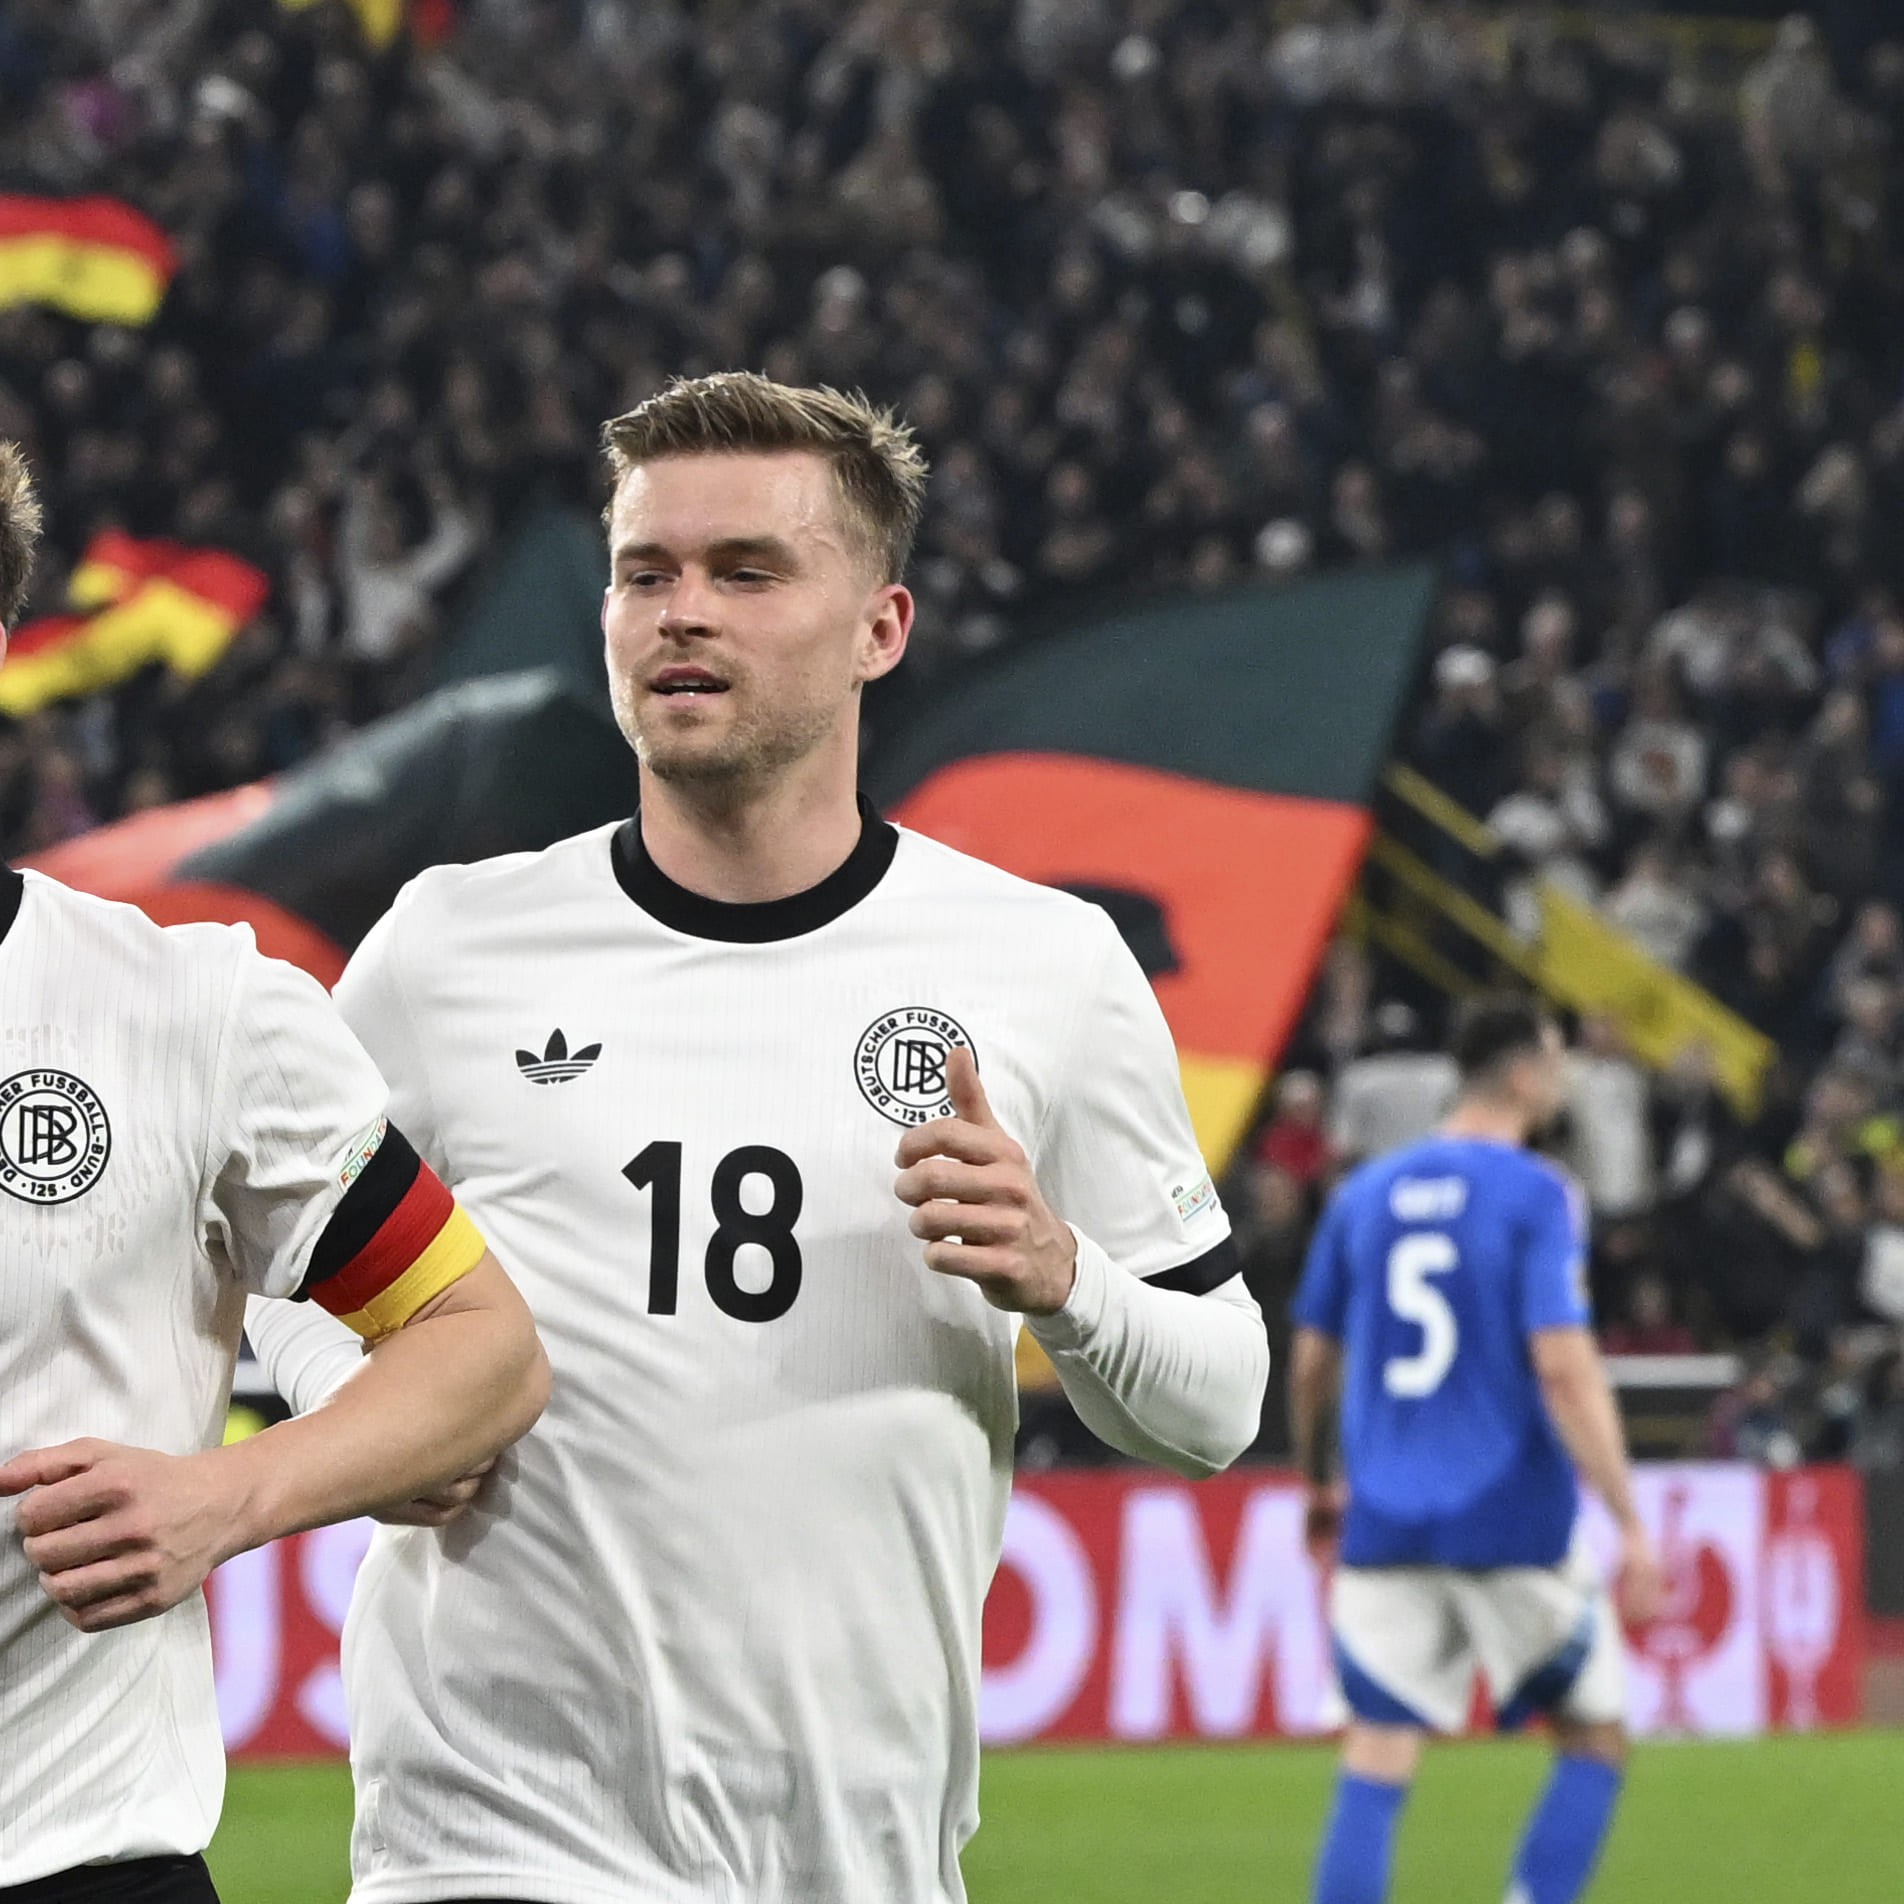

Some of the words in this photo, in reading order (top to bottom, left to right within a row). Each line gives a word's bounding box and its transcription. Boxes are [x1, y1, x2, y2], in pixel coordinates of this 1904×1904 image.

[30, 1073, 107, 1189] FUSSBALL-BUND
[30, 1181, 58, 1198] 125
[622, 1140, 803, 1323] 18
[1383, 1232, 1458, 1400] 5
